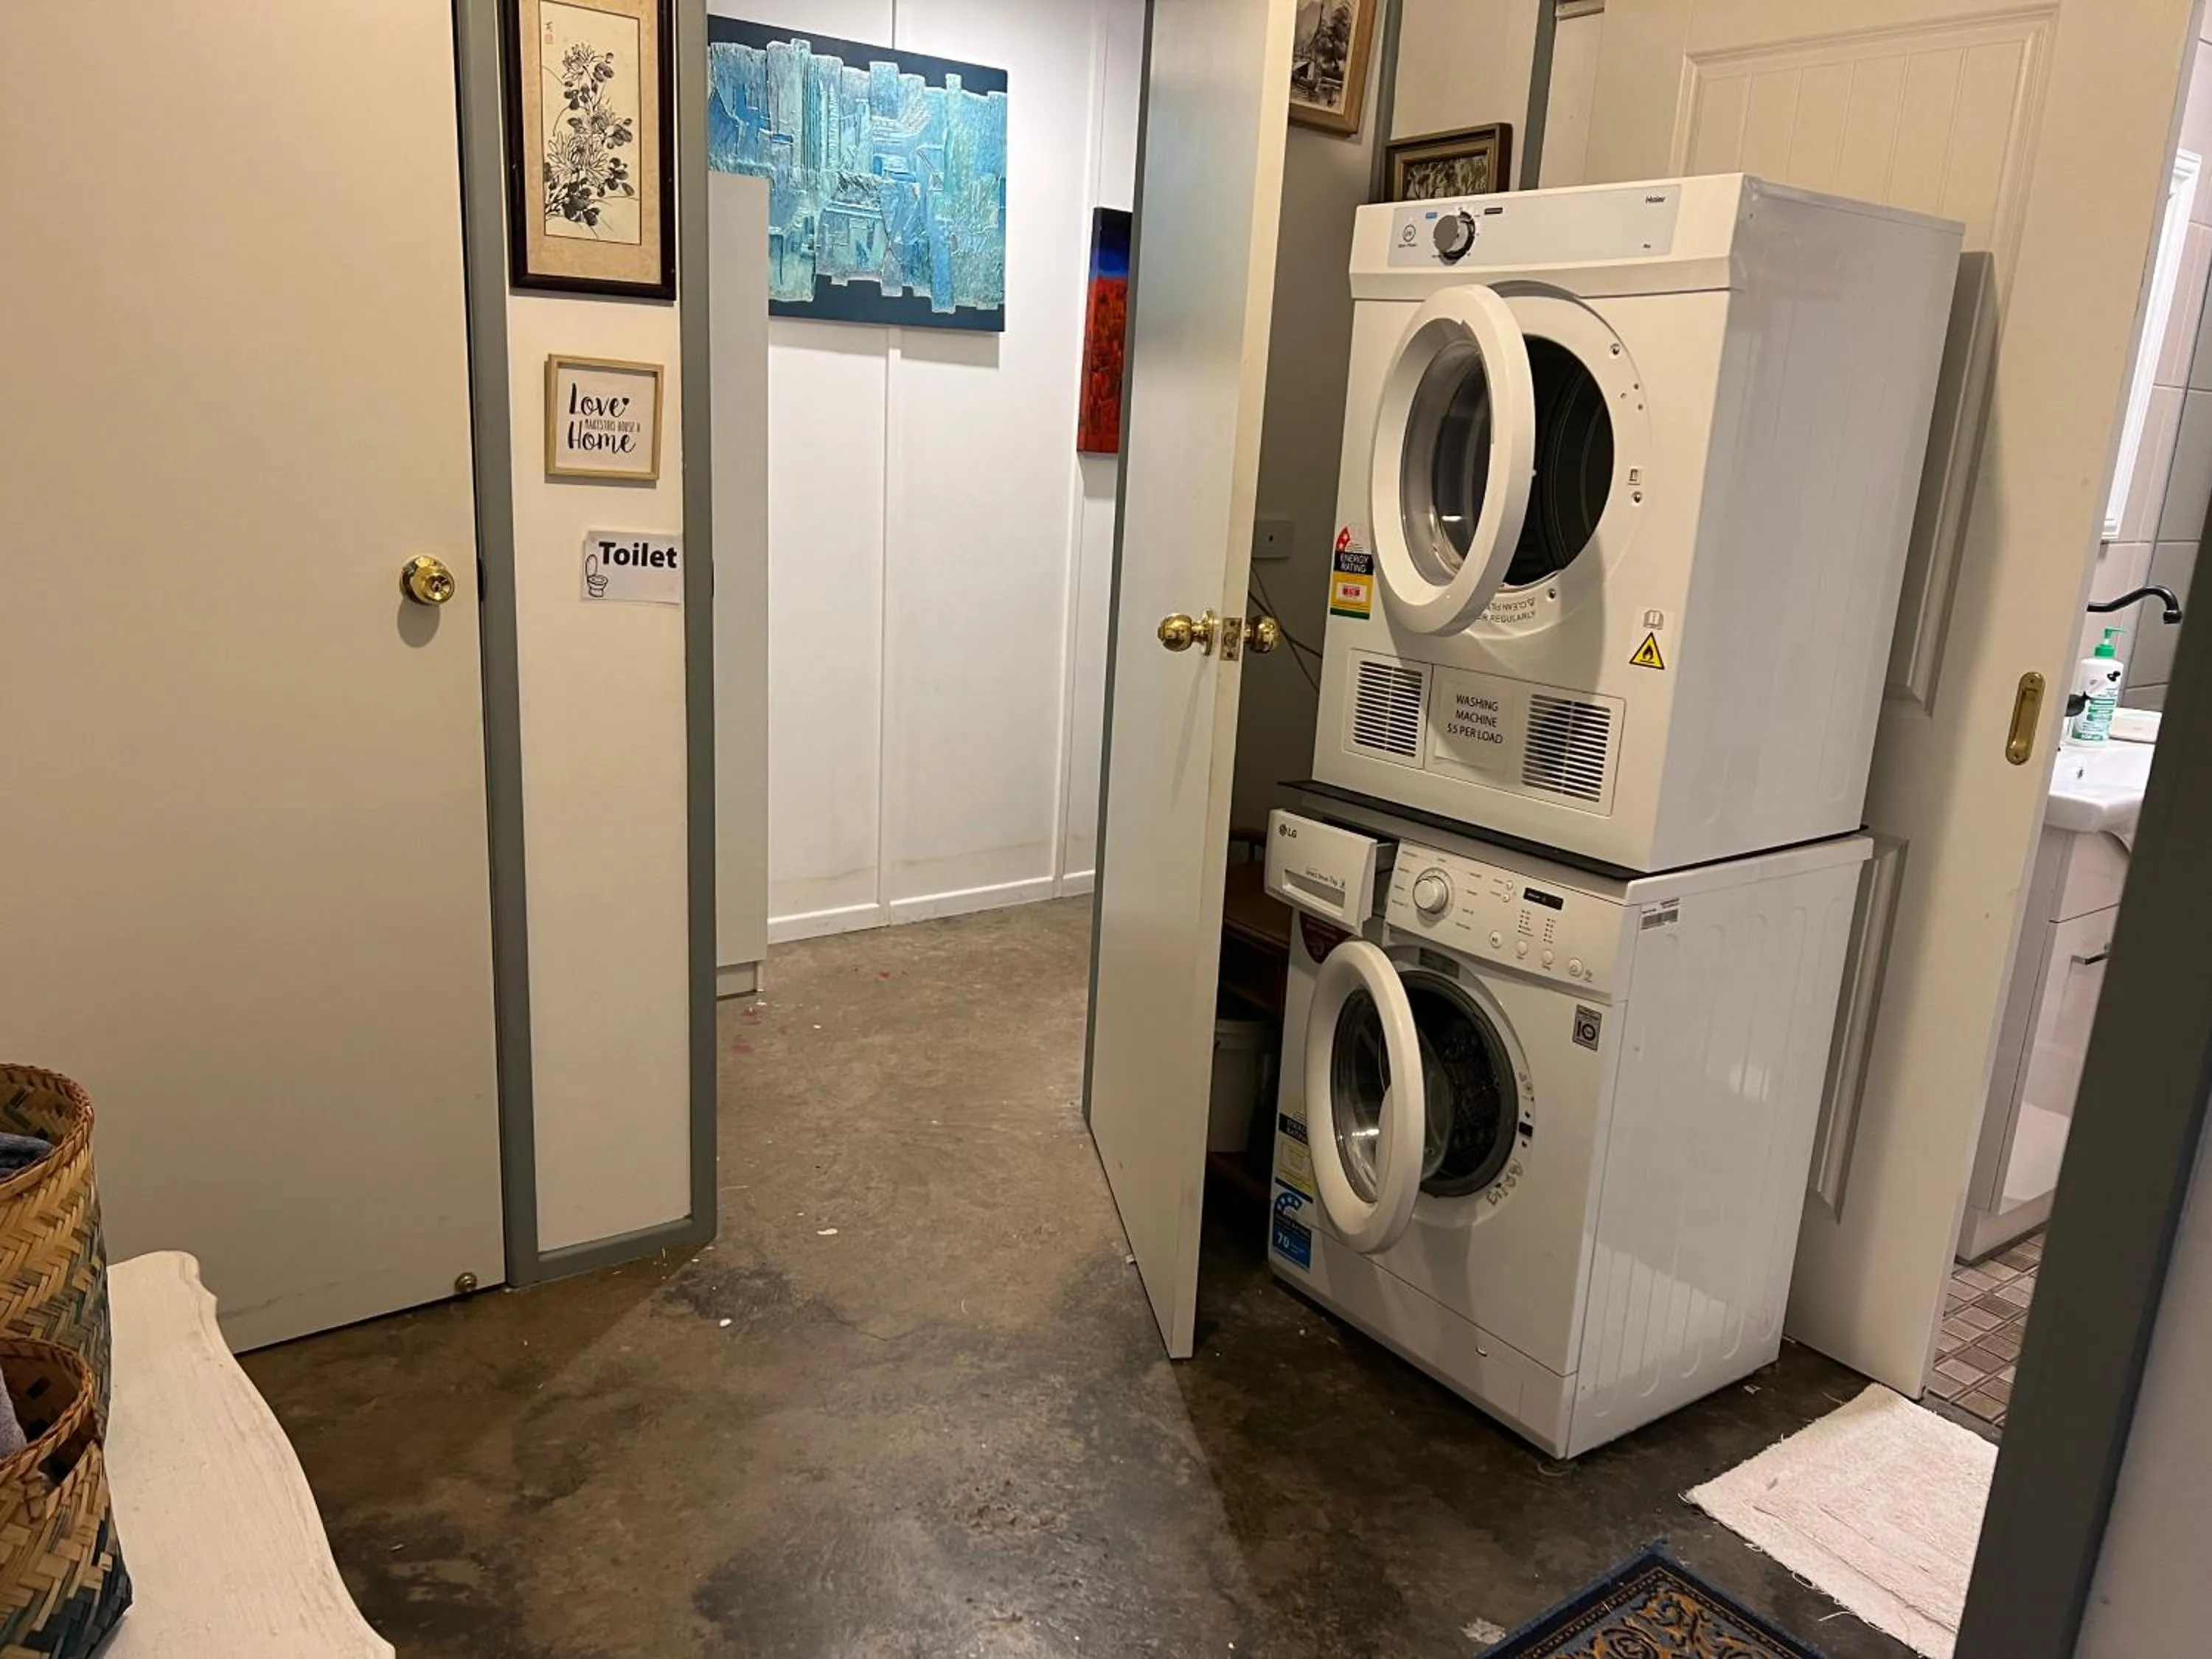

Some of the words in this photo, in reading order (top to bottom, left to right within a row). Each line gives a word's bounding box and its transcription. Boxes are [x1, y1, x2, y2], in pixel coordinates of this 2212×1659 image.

[569, 383, 626, 417] Love
[568, 420, 636, 453] Home
[599, 541, 678, 568] Toilet
[1340, 554, 1369, 564] ENERGY
[1340, 563, 1367, 573] RATING
[1456, 693, 1498, 712] WASHING
[1455, 709, 1498, 728] MACHINE
[1459, 726, 1476, 738] PER
[1477, 729, 1503, 744] LOAD
[1287, 827, 1297, 838] LG
